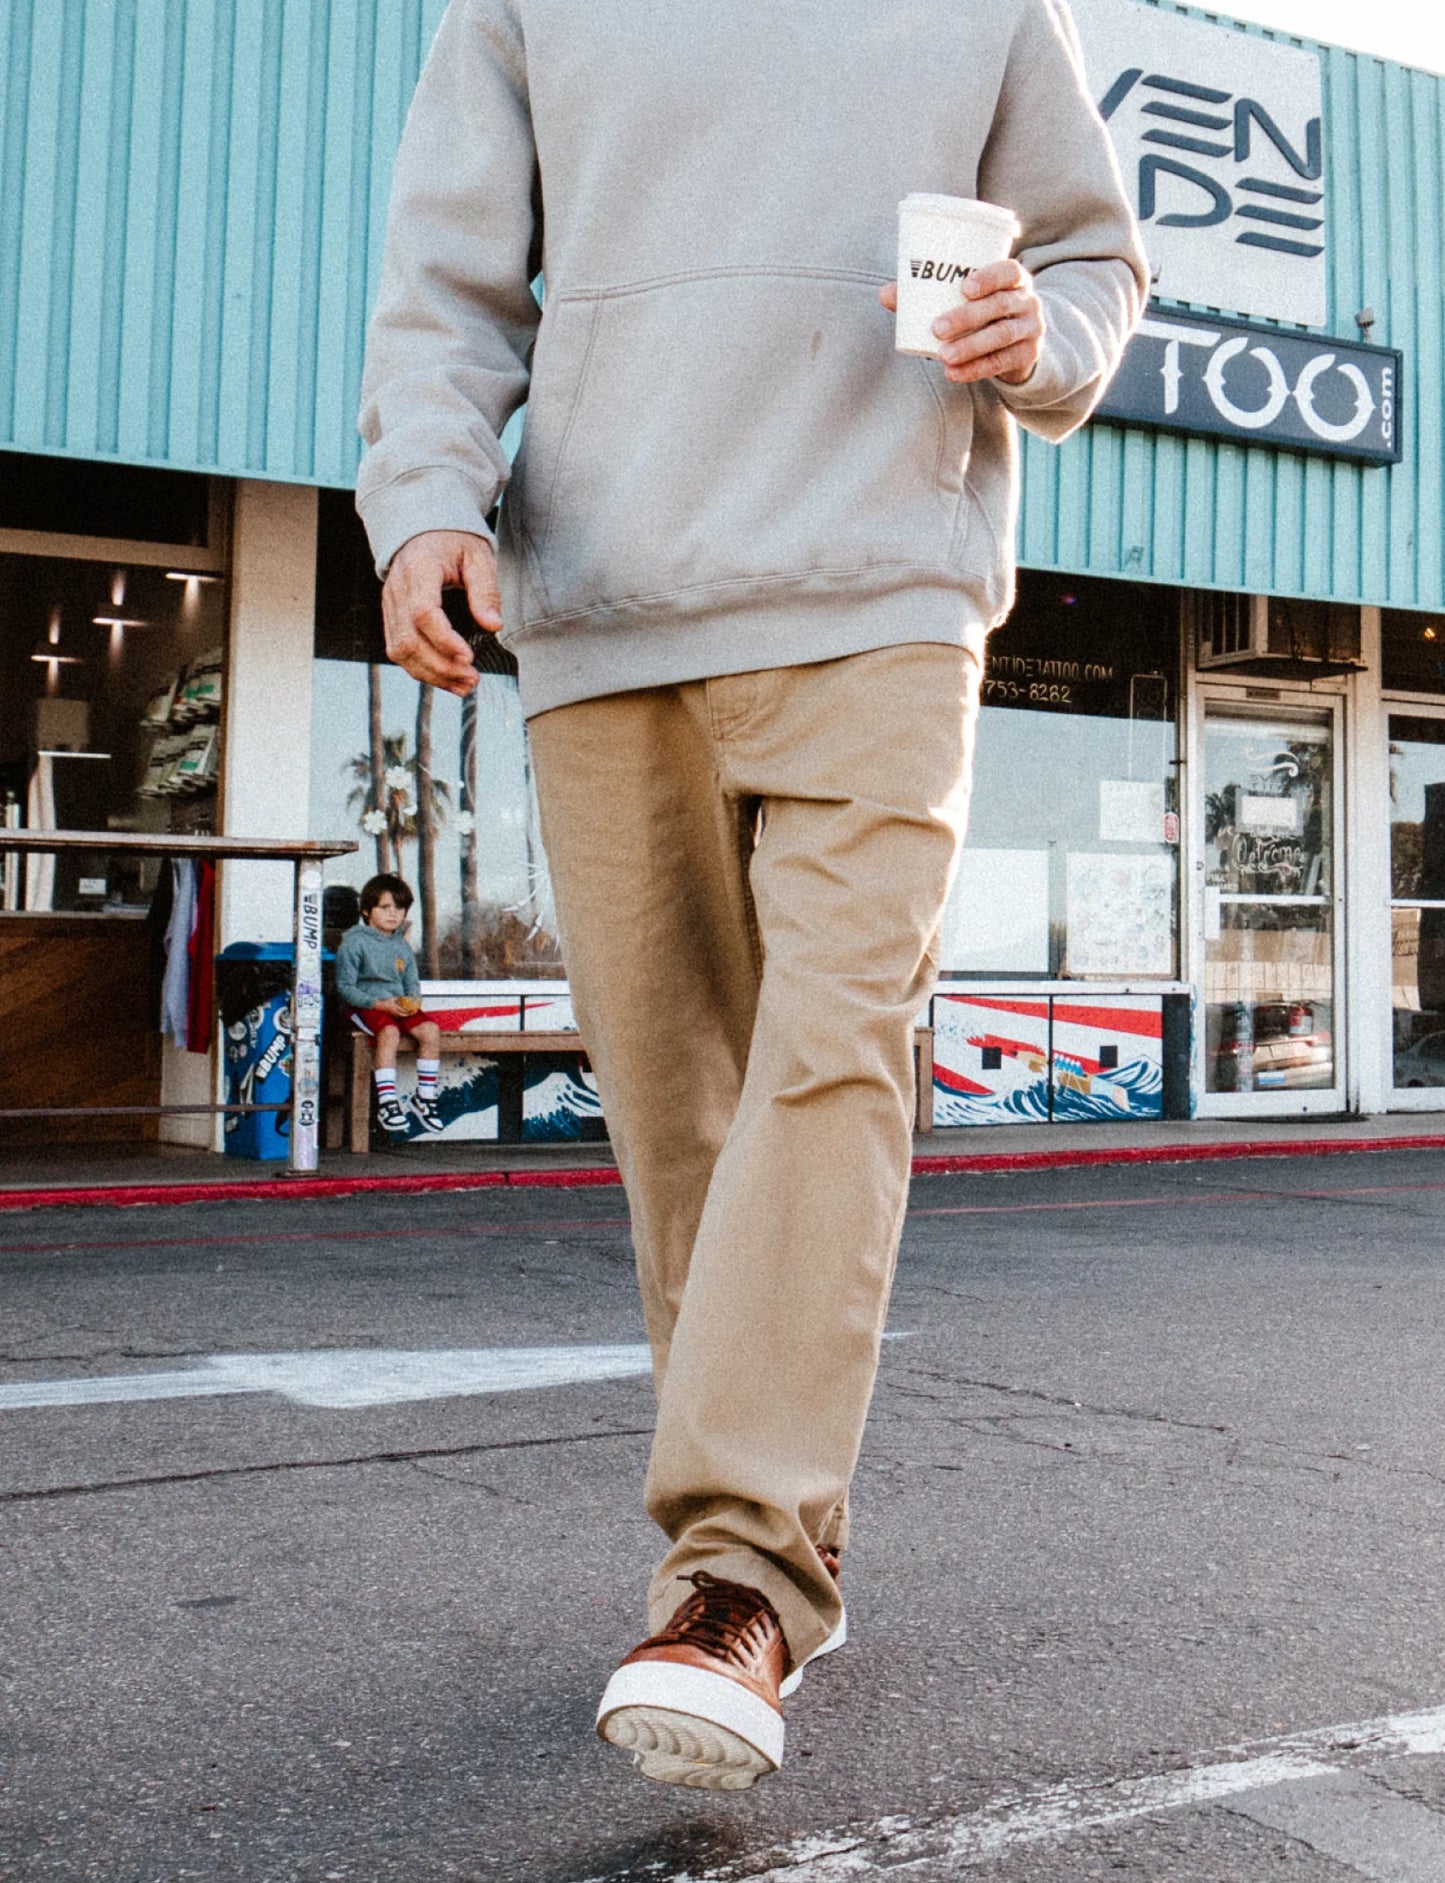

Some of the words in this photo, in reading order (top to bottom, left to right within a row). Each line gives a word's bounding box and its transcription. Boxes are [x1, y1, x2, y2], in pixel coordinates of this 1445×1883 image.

[921, 260, 978, 284] BUM
[1381, 366, 1392, 448] .com
[303, 904, 318, 951] BUMP
[259, 1033, 287, 1075] BUMP
